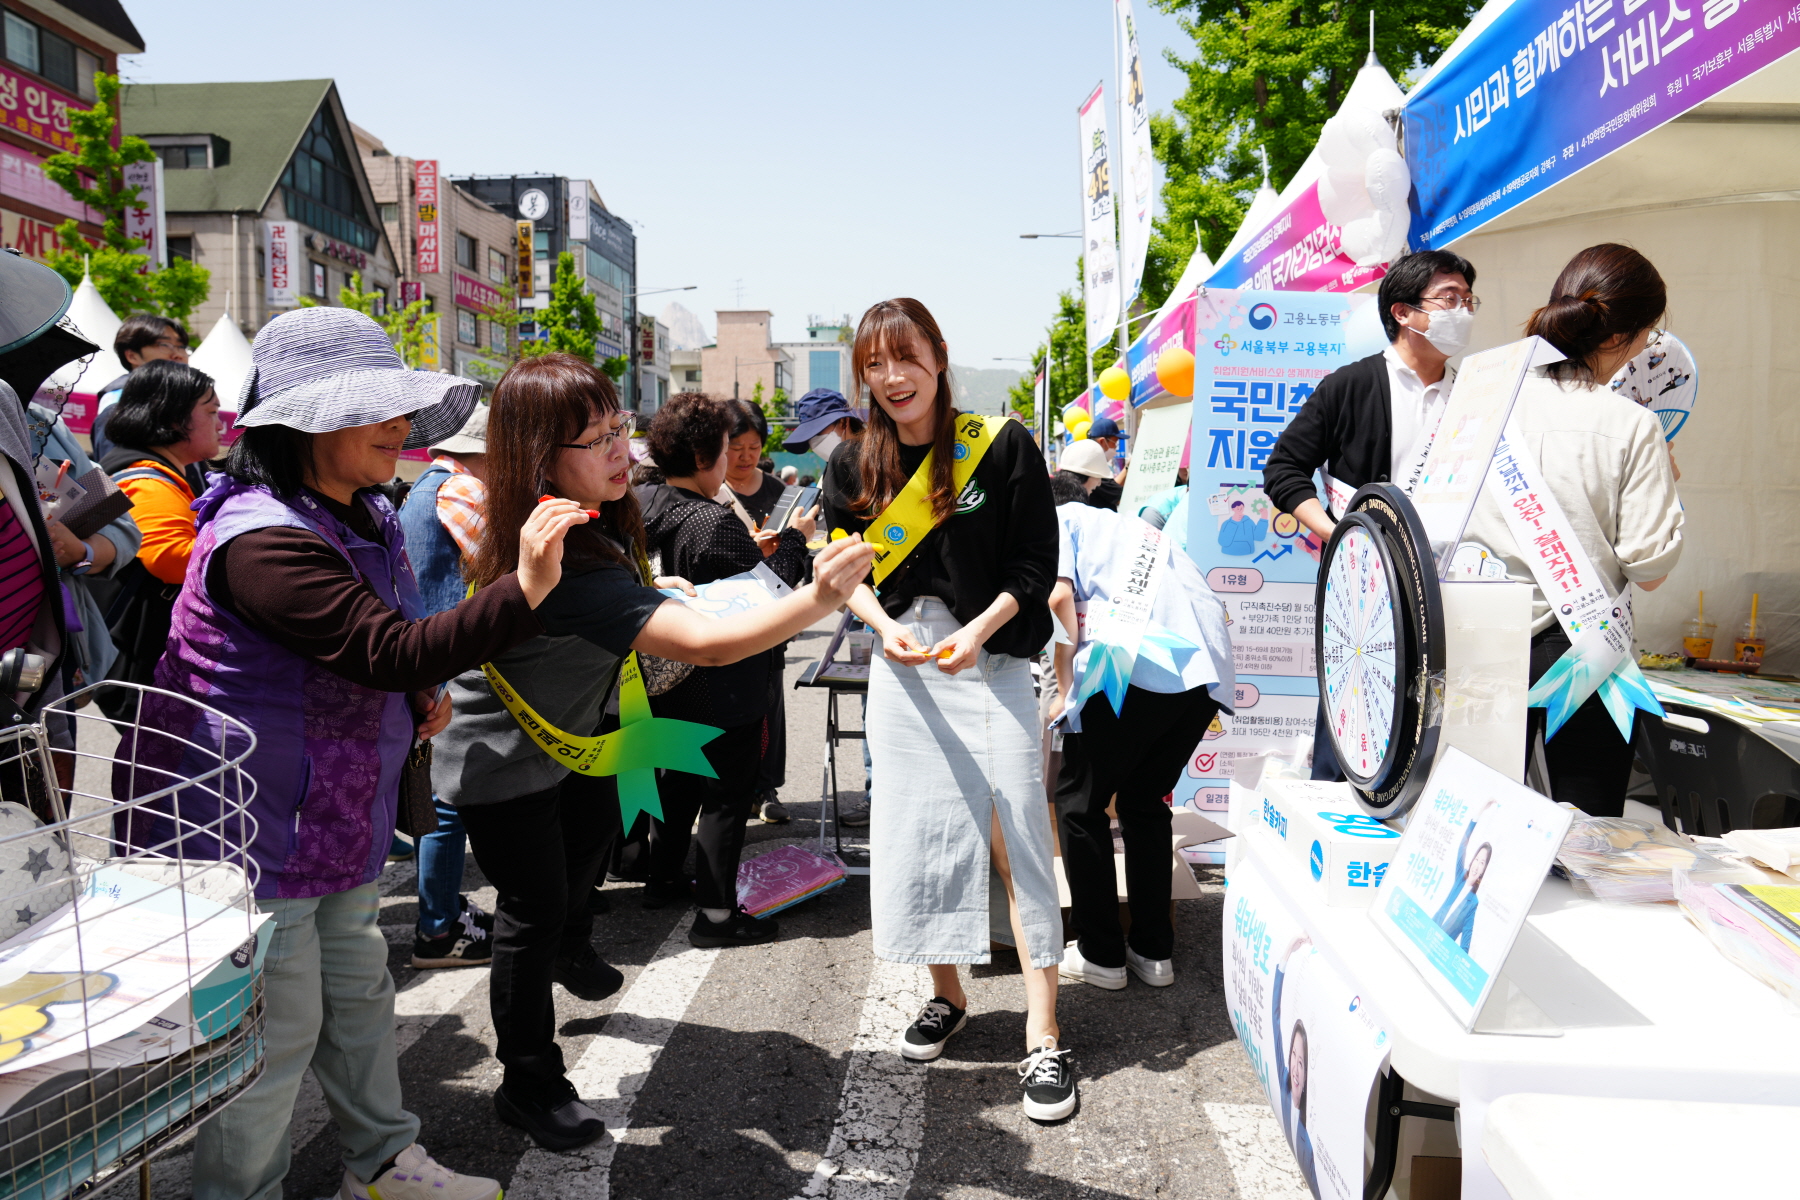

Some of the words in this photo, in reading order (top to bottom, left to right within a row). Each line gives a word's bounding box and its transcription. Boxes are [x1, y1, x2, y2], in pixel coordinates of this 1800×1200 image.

[1599, 0, 1694, 98] 서비스
[1453, 72, 1511, 145] 시민과
[1513, 0, 1615, 99] 함께하는
[1540, 155, 1557, 173] 강북구
[1562, 143, 1575, 160] 주관
[1666, 77, 1683, 97] 후원
[1692, 47, 1734, 80] 국가보훈부
[1736, 16, 1783, 55] 서울특별시
[641, 316, 655, 329] OK
[1283, 312, 1341, 326] 고용노동부
[1240, 340, 1289, 355] 서울북부
[1293, 341, 1346, 357] 고용복지
[1213, 365, 1285, 378] 취업지원서비스와
[1496, 454, 1530, 496] 그날까지
[1512, 492, 1546, 531] 안전!
[1123, 553, 1156, 597] 시작하세요
[1368, 498, 1398, 527] DARTPOWER
[1397, 522, 1417, 569] TURNING
[1413, 567, 1424, 602] DART
[1419, 604, 1428, 644] GAME
[1533, 529, 1583, 594] 절대지켜!!
[1221, 574, 1247, 586] 1유형
[1240, 601, 1293, 612] (구직촉진수당)
[1294, 603, 1302, 612] 월
[1249, 614, 1280, 624] 부양가족
[1282, 615, 1302, 625] 1인당
[1239, 626, 1247, 635] 월
[1249, 626, 1264, 635] 최대
[1266, 627, 1292, 636] 40만원
[1245, 654, 1268, 662] 중위소득
[518, 709, 587, 760] 캠페인
[1231, 716, 1284, 726] (취업활동비용)
[1285, 717, 1316, 727] 참여수당
[1231, 727, 1247, 736] 최대
[1249, 728, 1271, 737] 195만
[1272, 729, 1293, 737] 4천원
[1219, 751, 1235, 759] (연령)
[1206, 793, 1230, 804] 일경험
[1433, 788, 1470, 828] 워라밸로
[1263, 798, 1288, 841] 한솔카피
[1438, 822, 1456, 845] 미래도
[1431, 838, 1447, 861] 만족도
[1405, 850, 1445, 900] 키워라!
[1234, 896, 1272, 976] 워라밸로
[1248, 968, 1265, 1009] 미래도
[1247, 994, 1264, 1040] 만족도
